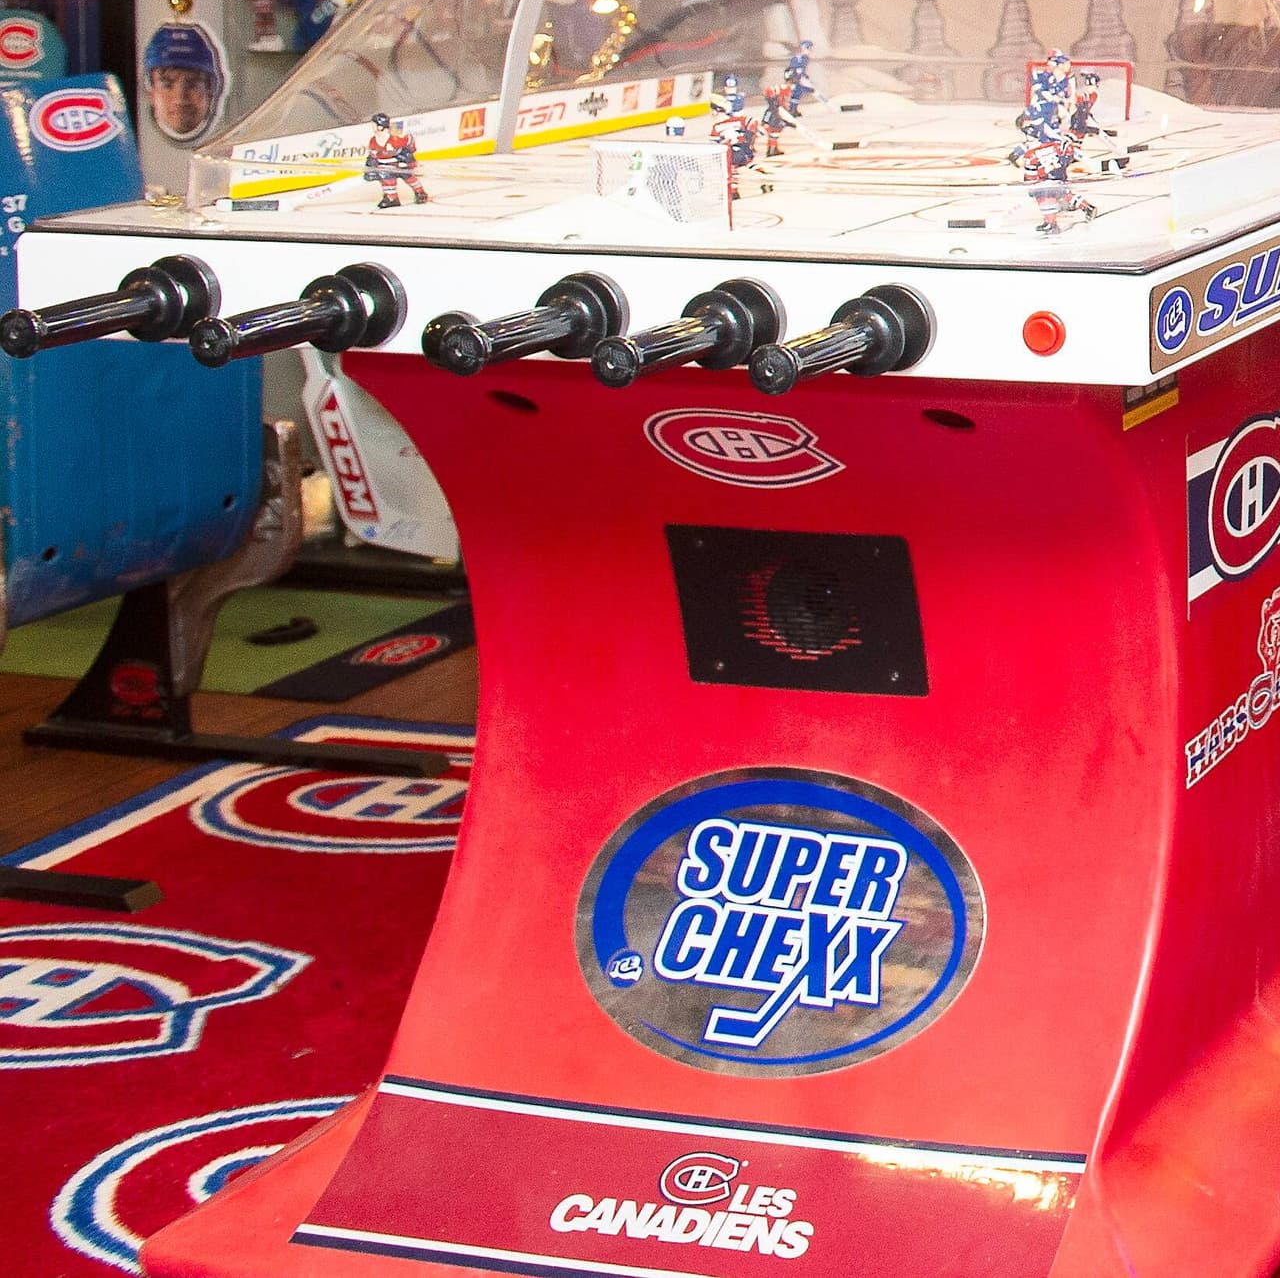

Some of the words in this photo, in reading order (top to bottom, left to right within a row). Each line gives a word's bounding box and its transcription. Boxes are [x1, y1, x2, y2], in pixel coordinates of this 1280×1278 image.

[517, 101, 567, 129] TSN
[2, 194, 28, 214] 37
[319, 408, 377, 515] CCM
[677, 818, 909, 920] SUPER
[655, 897, 905, 1009] CHEXX
[549, 1192, 815, 1259] CANADIENS
[728, 1183, 798, 1220] LES
